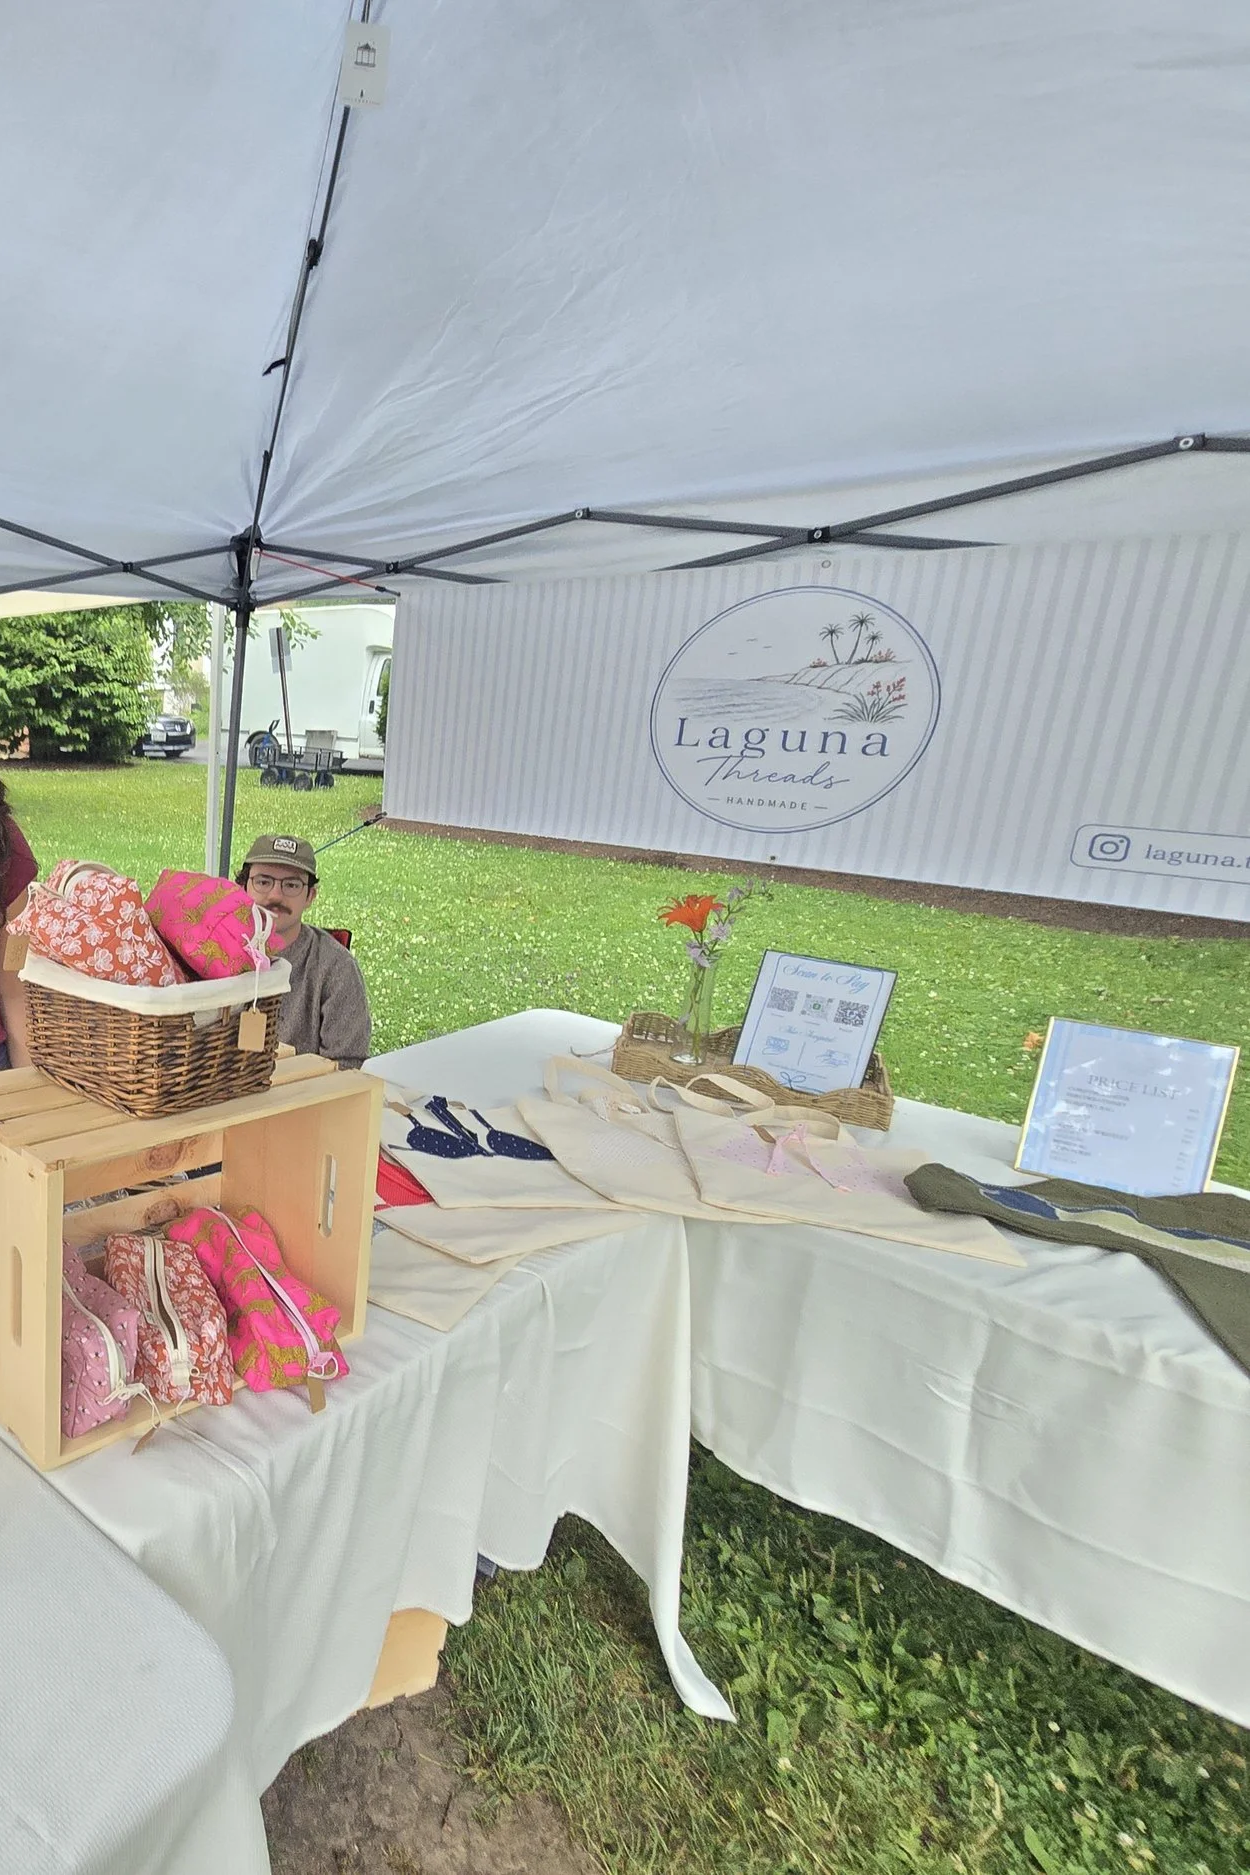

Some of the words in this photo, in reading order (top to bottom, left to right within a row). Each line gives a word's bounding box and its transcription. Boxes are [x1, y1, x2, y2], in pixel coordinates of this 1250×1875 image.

[674, 717, 889, 758] Laguna
[697, 754, 850, 789] Threads
[725, 796, 808, 811] HANDMADE
[820, 972, 833, 981] to
[1087, 1074, 1140, 1092] PRICE
[1142, 1084, 1180, 1100] LIST
